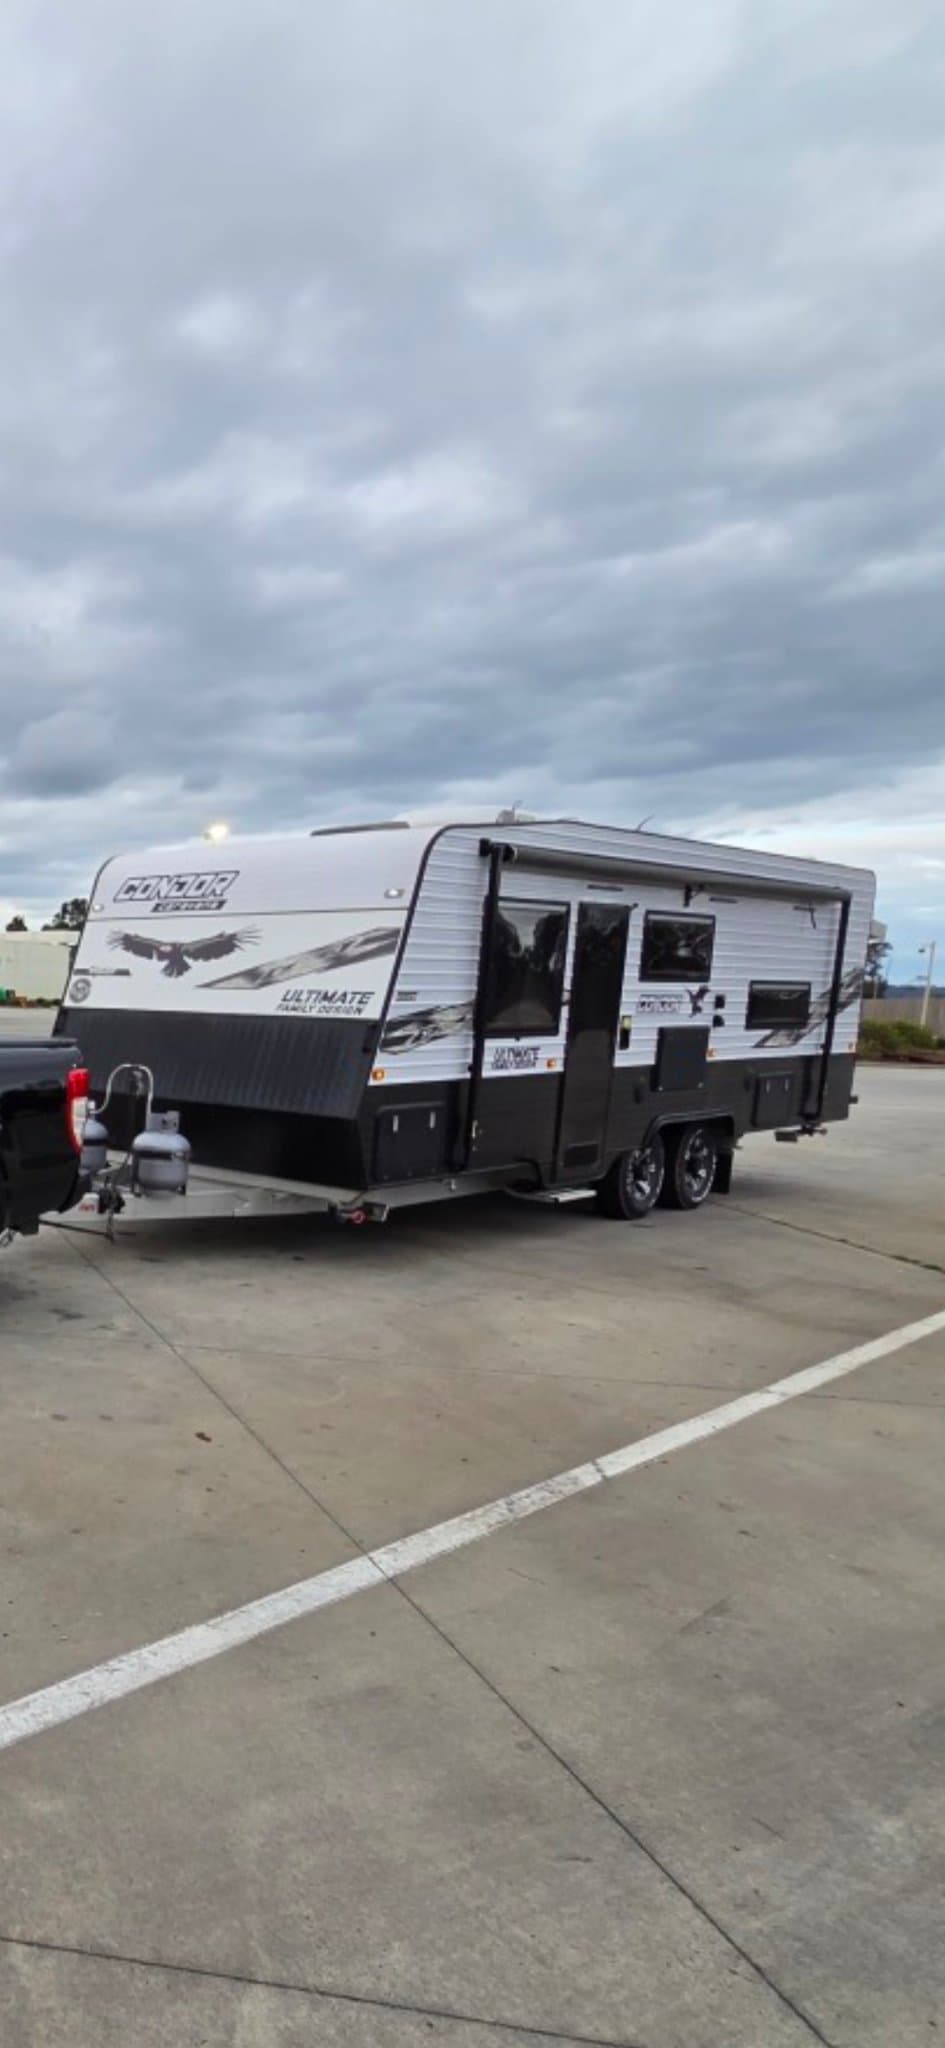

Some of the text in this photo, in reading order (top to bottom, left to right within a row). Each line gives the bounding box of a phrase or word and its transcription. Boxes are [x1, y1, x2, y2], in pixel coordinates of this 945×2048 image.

[112, 870, 240, 903] CONDOR
[281, 989, 375, 1005] ULTIMATE
[276, 1003, 364, 1017] FAMILY DESIGN
